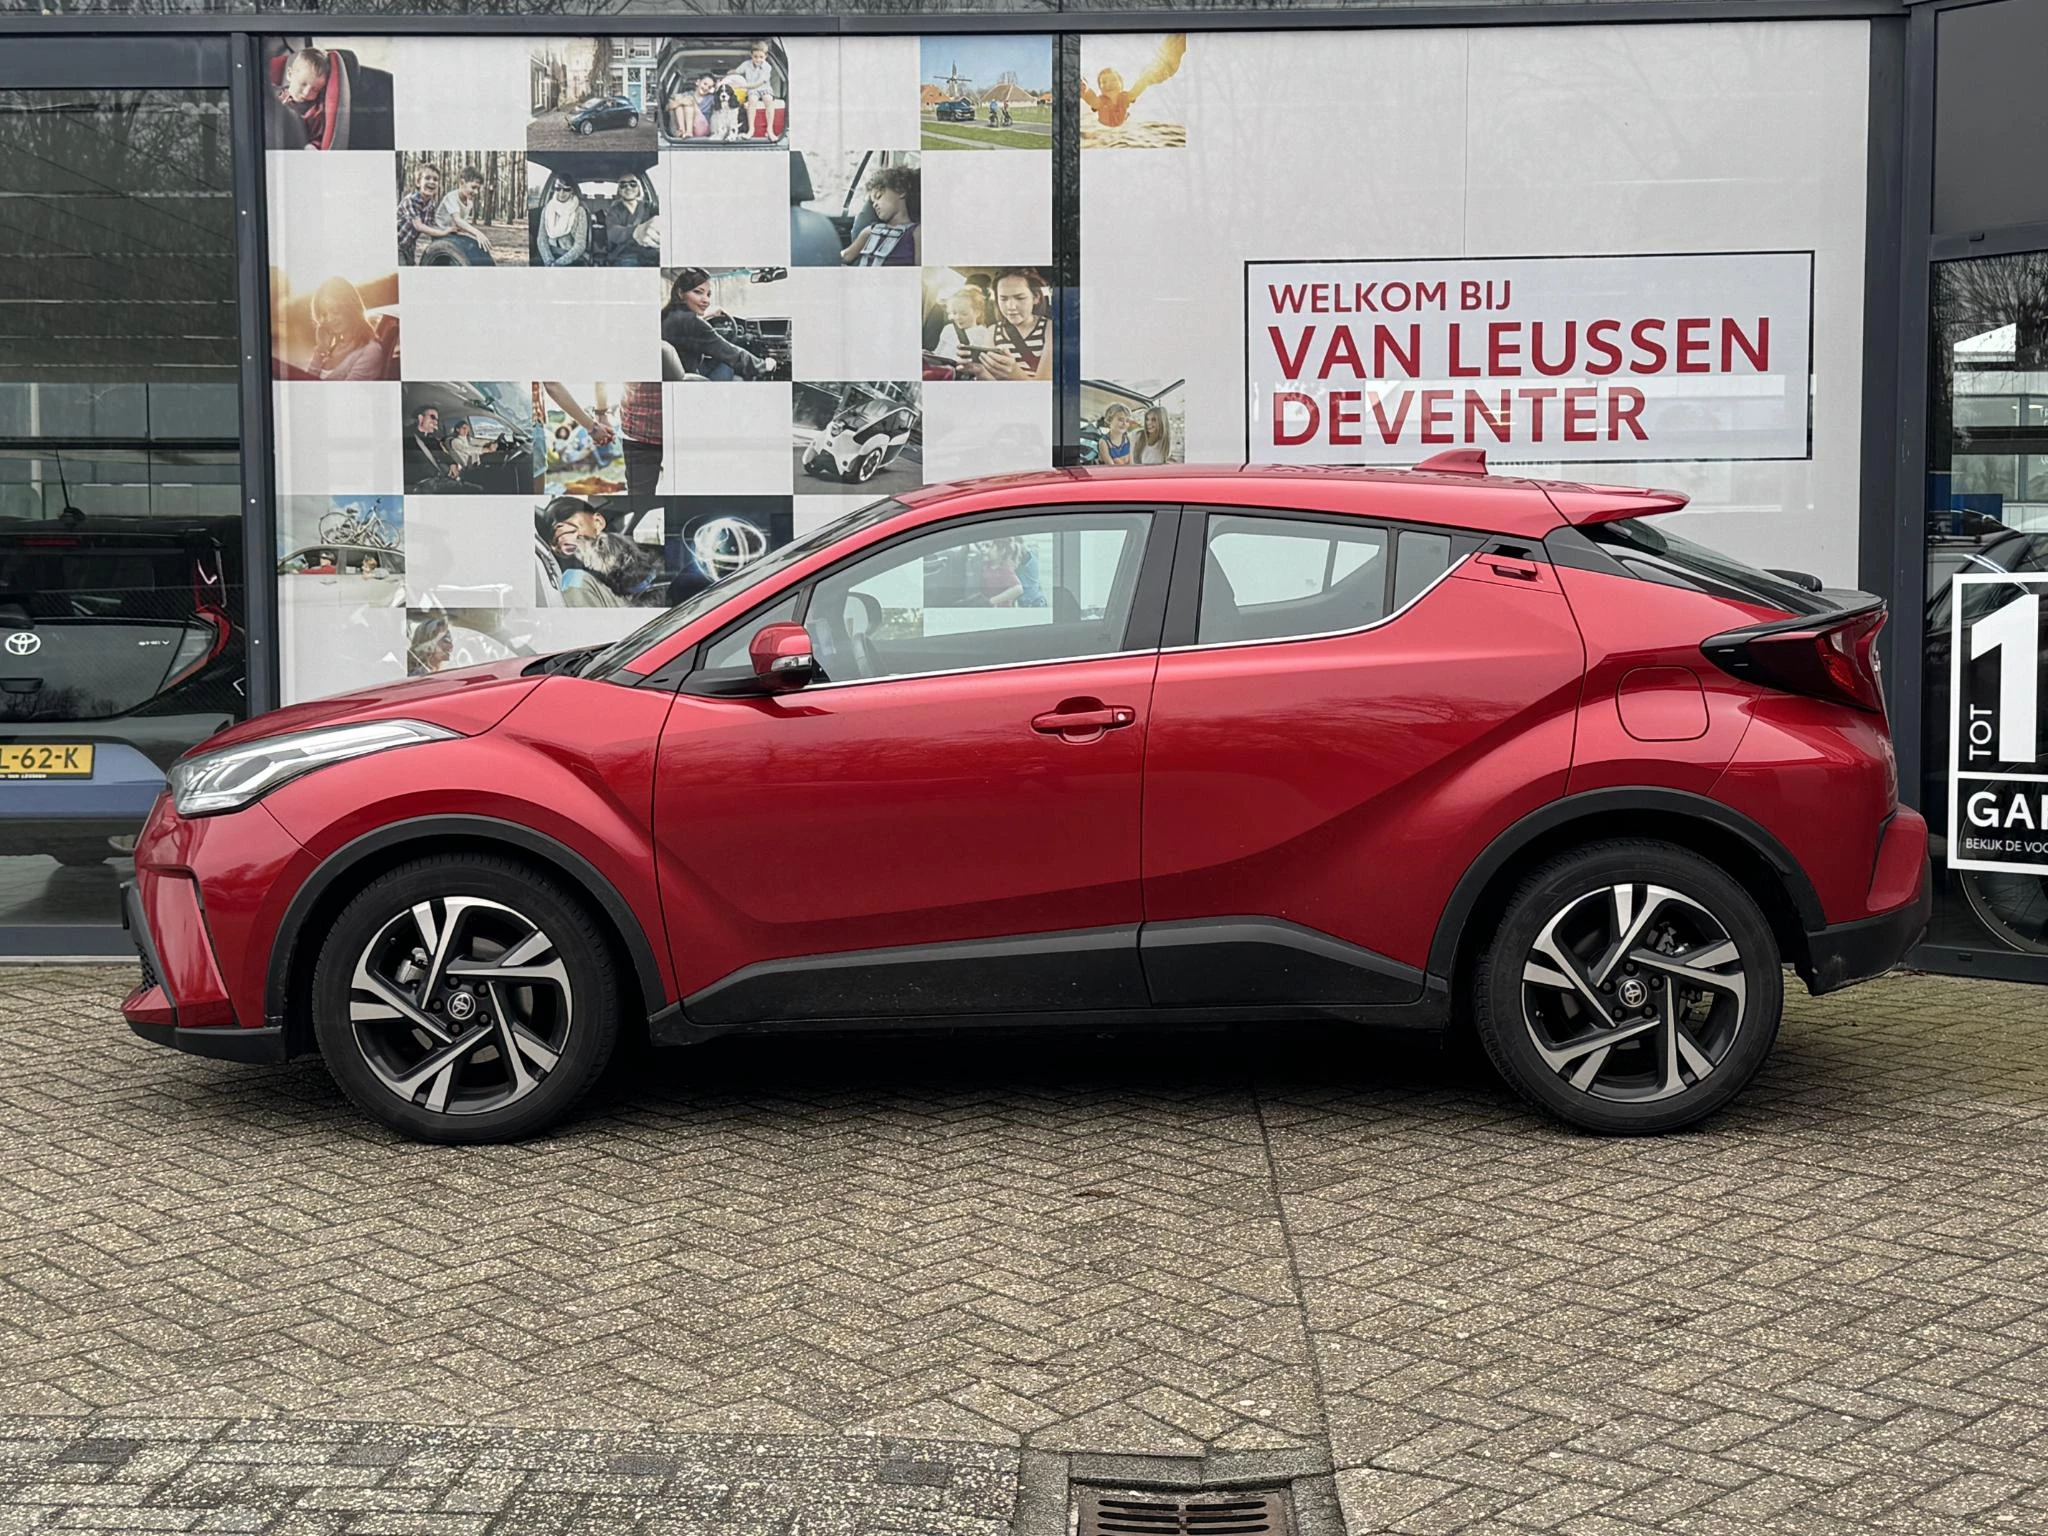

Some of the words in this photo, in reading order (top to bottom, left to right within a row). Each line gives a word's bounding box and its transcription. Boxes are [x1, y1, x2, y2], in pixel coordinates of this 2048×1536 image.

[1268, 281, 1447, 313] WELKOM
[1460, 280, 1511, 310] BIJ
[1268, 323, 1421, 380] VAN
[1448, 317, 1770, 377] LEUSSEN
[1272, 387, 1650, 446] DEVENTER
[1968, 703, 1993, 761] TOT
[1966, 791, 2048, 830] GA
[1965, 837, 2003, 851] BEKIJK
[2005, 839, 2022, 852] DE
